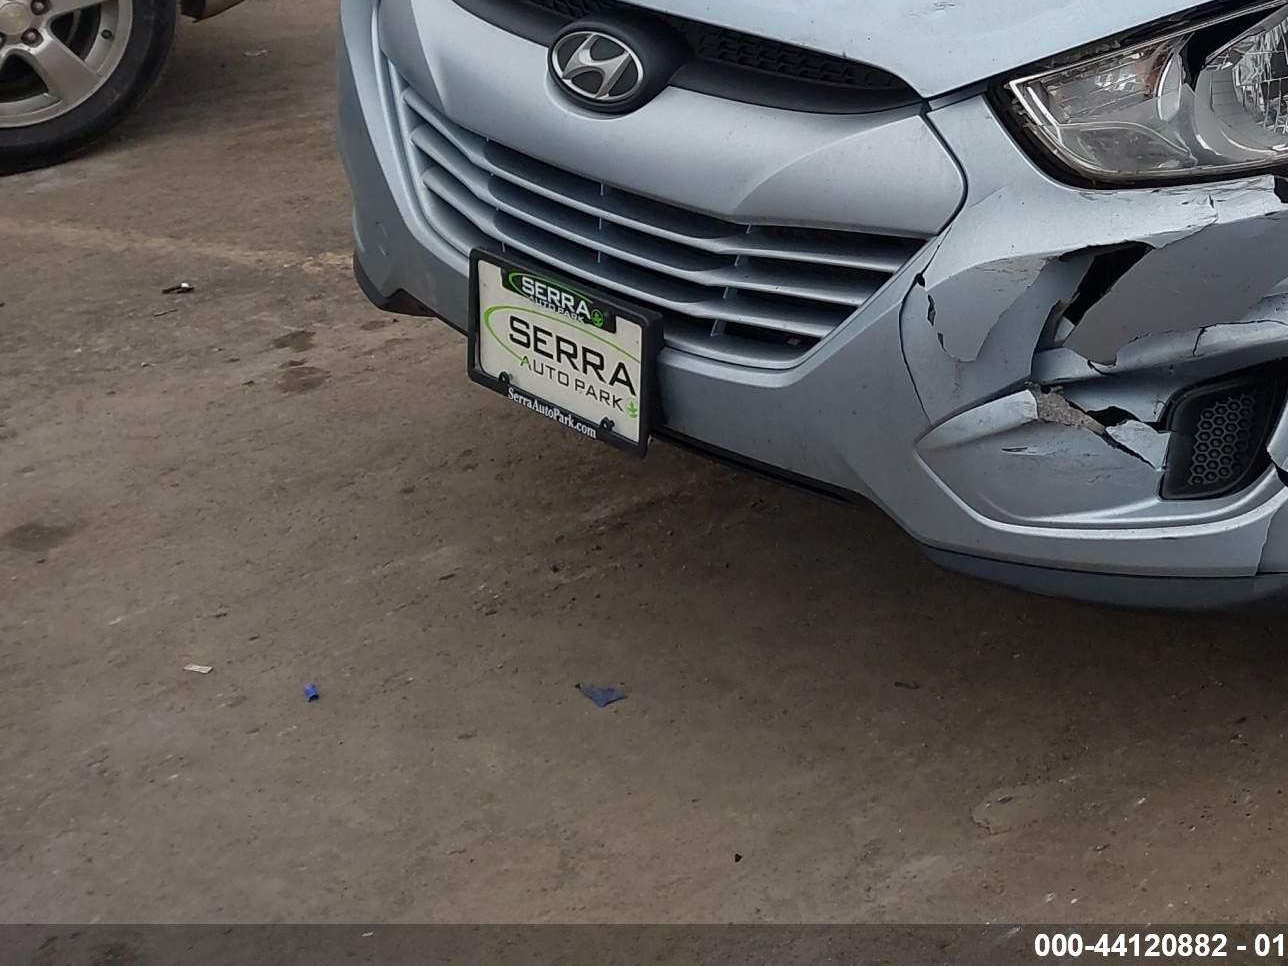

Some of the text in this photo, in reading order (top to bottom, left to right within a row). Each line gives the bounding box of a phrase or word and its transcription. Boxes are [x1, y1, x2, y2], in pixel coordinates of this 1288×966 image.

[521, 276, 591, 319] SERRA
[508, 315, 637, 396] SERRA
[520, 355, 625, 412] AUTO PARK
[507, 387, 596, 439] SerraAutoPark.com
